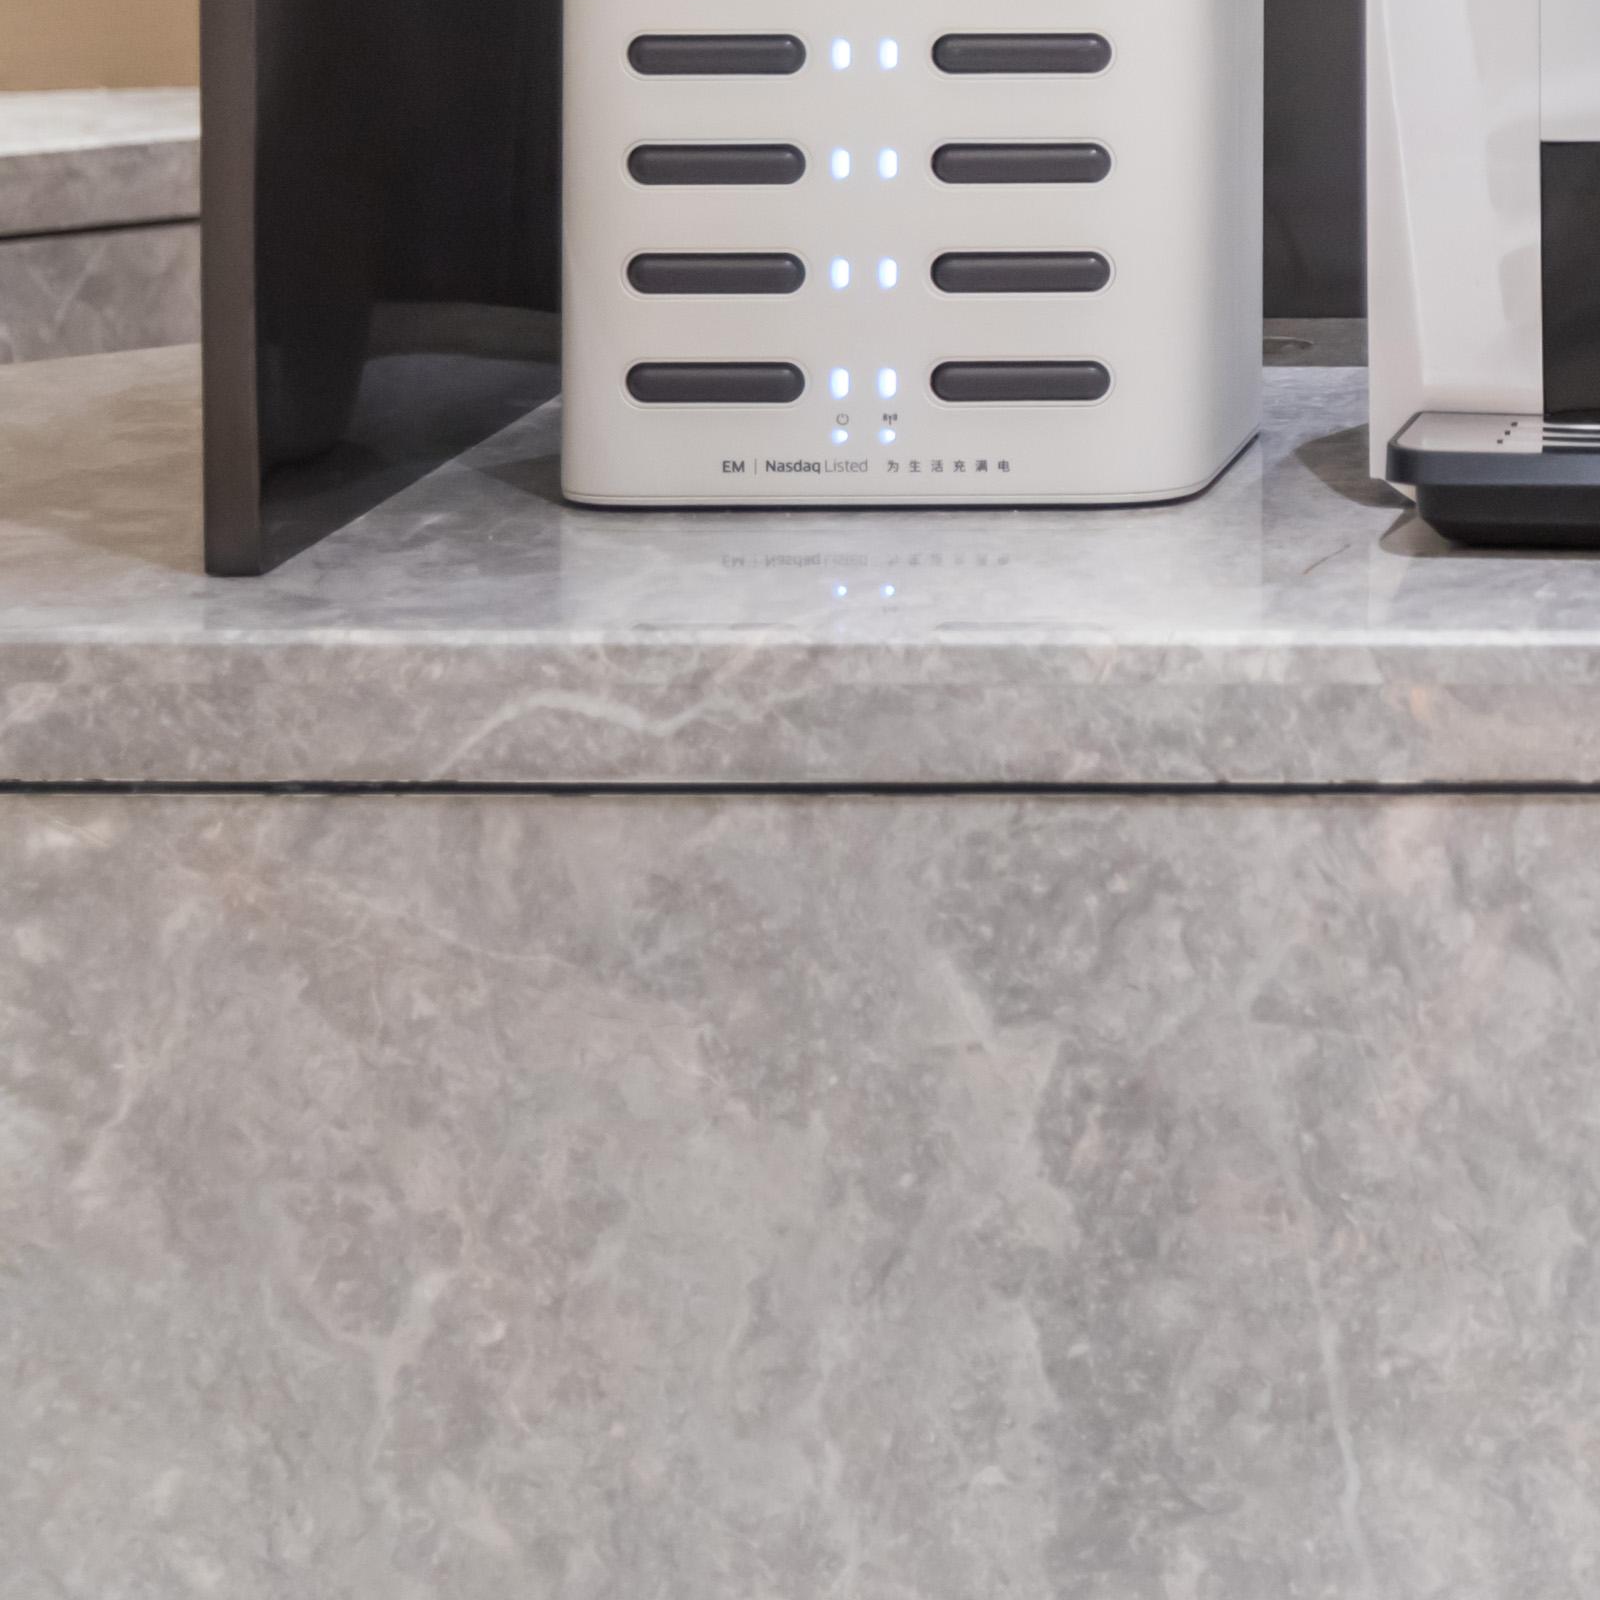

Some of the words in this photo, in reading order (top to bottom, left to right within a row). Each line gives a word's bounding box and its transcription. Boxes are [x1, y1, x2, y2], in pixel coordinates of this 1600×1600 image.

[722, 460, 745, 473] EM
[765, 460, 821, 474] Nasdaq
[825, 459, 868, 473] Listed
[887, 459, 1010, 473] 为生活充满电
